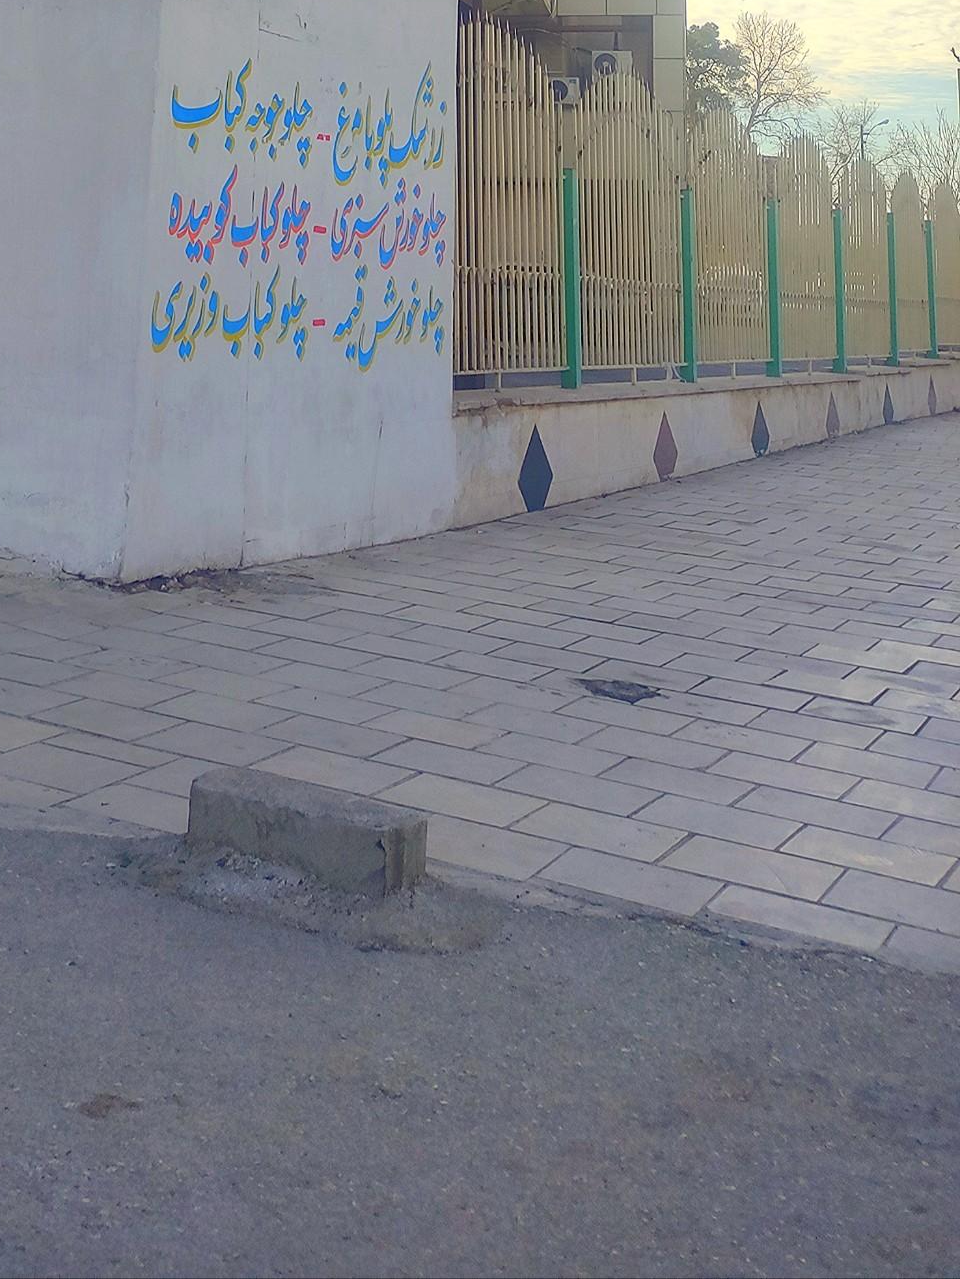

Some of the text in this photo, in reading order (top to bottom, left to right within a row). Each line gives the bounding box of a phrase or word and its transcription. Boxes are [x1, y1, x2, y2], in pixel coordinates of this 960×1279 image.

[171, 57, 252, 154] کباب
[169, 164, 238, 266] کوبیده
[231, 181, 284, 268] کباب
[279, 184, 311, 265] چلو
[331, 193, 389, 262] سبزی
[151, 272, 219, 362] وزیری
[222, 264, 280, 360] کباب
[276, 276, 307, 362] چلو
[333, 264, 368, 362] قیمه
